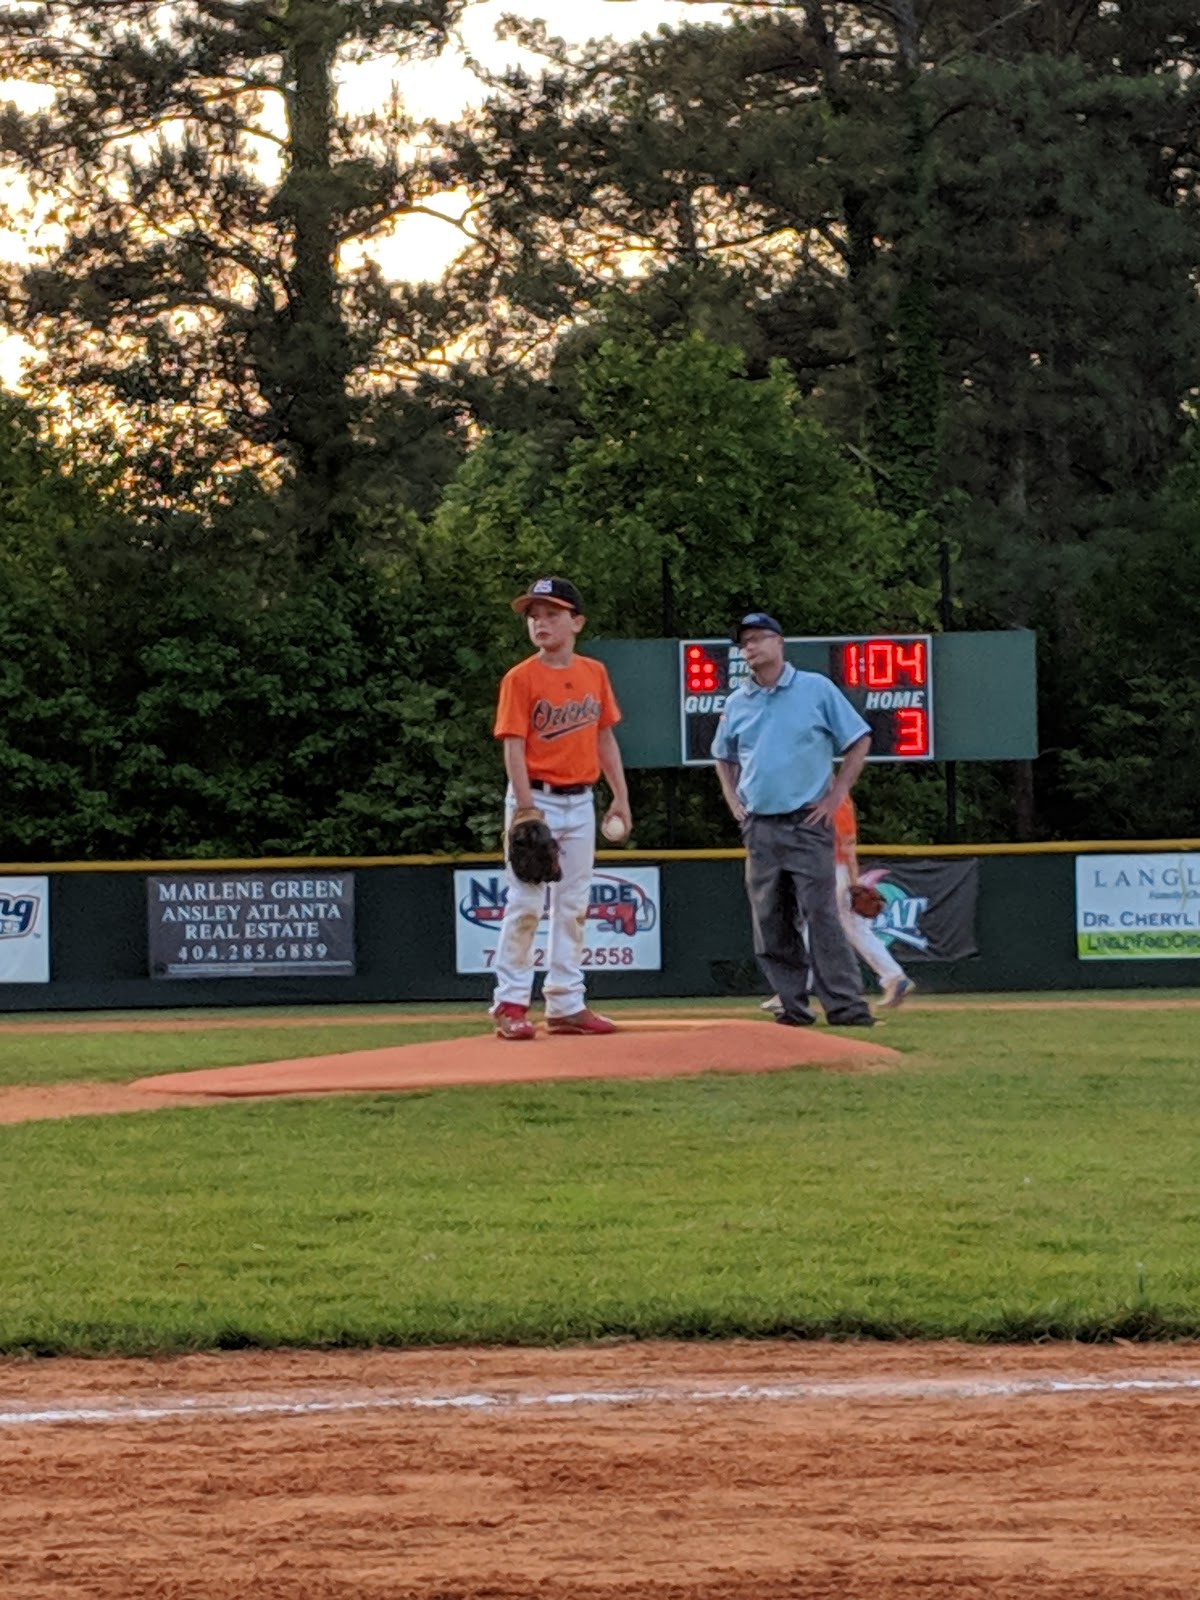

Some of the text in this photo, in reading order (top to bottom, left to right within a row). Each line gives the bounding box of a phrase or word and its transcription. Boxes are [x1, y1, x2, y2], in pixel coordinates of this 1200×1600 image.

[685, 695, 727, 713] GUE
[865, 691, 925, 709] HOME
[897, 709, 926, 754] 3
[1094, 868, 1200, 888] LANGL
[159, 880, 344, 901] MARLENE GREEN
[161, 903, 341, 922] ANSLEY ATLANTA
[1120, 911, 1194, 926] CHERYL
[185, 922, 319, 940] REAL ESTATE
